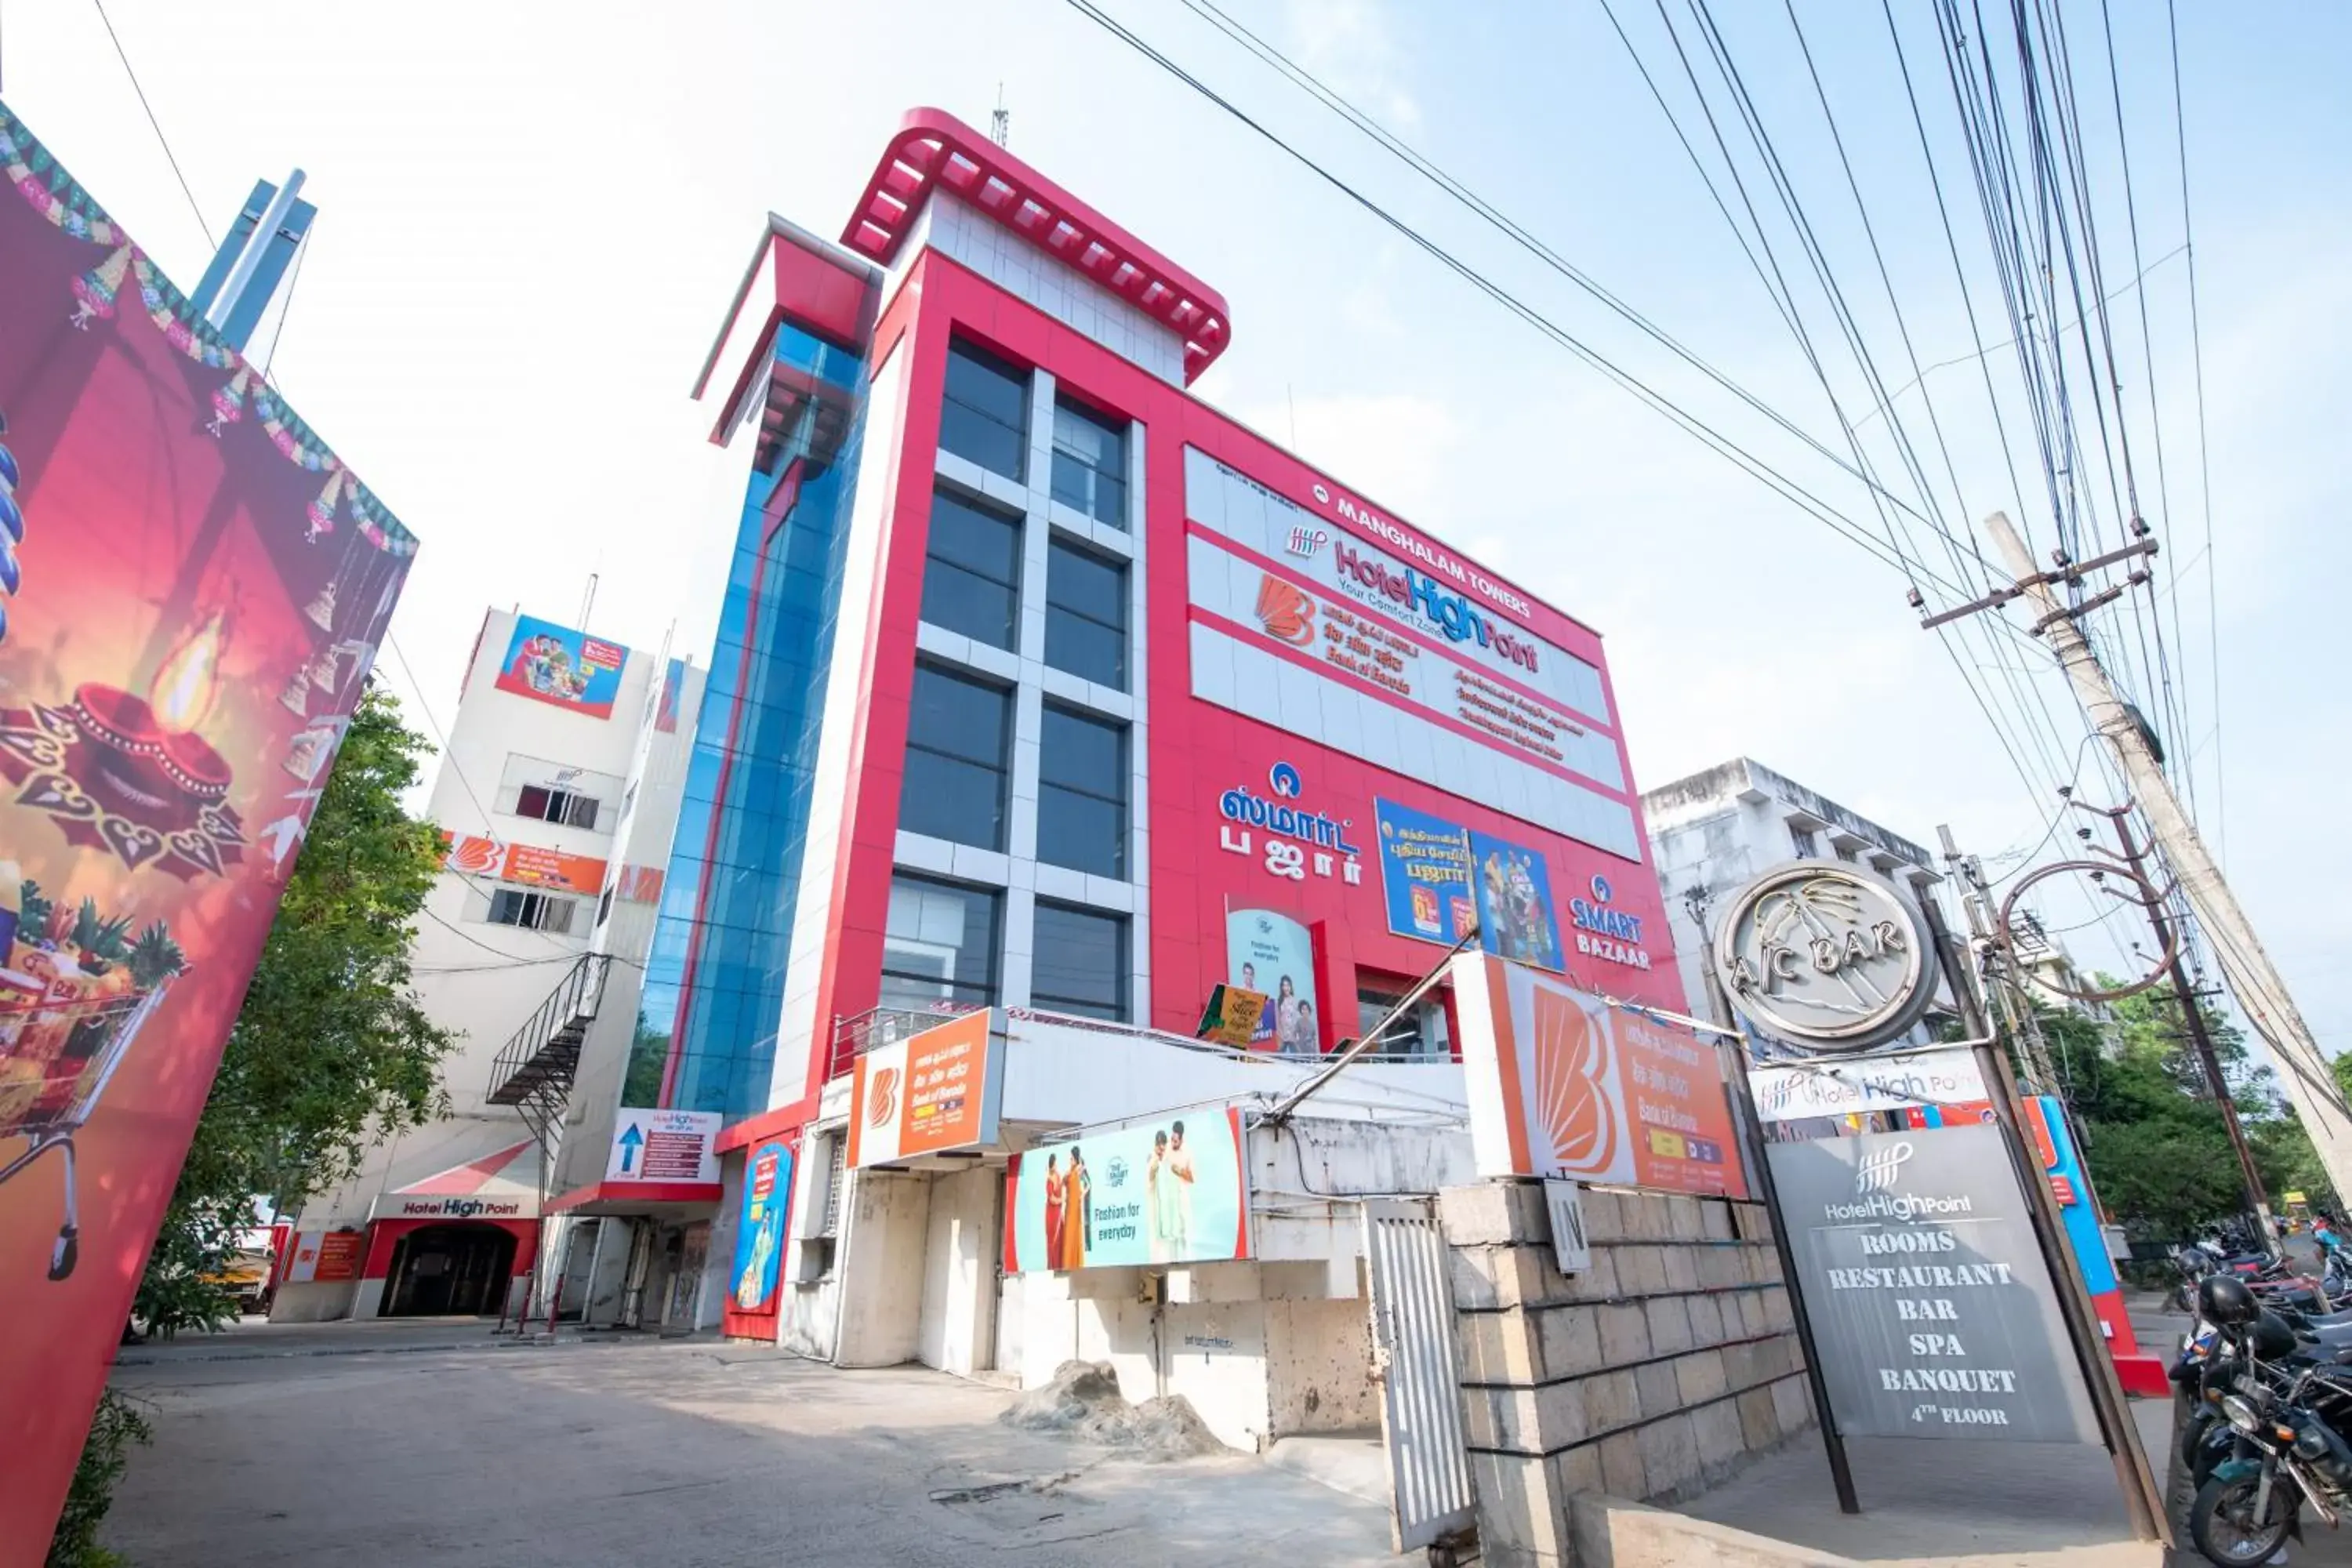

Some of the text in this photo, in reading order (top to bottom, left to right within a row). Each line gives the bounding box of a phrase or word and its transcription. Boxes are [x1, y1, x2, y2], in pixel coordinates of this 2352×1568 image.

[1338, 497, 1530, 619] MANGHALAM TOWERS
[1338, 576, 1445, 638] Your Comfort Zone
[1220, 786, 1359, 855] ஸ்மார்ட்
[1570, 896, 1642, 945] SMART
[1576, 935, 1651, 971] BAZAAR
[1863, 1073, 1927, 1102] High
[403, 1199, 520, 1218] Hotel High Point
[1094, 1201, 1140, 1221] Fashion for
[1098, 1224, 1137, 1241] everyday
[1860, 1230, 1956, 1255] ROOMS
[1827, 1262, 2012, 1290] RESTAURANT
[1896, 1298, 1958, 1320] BAR
[1909, 1334, 1966, 1356] SPA
[1879, 1367, 2016, 1393] BANQUET
[1940, 1406, 2009, 1425] FLOOR
